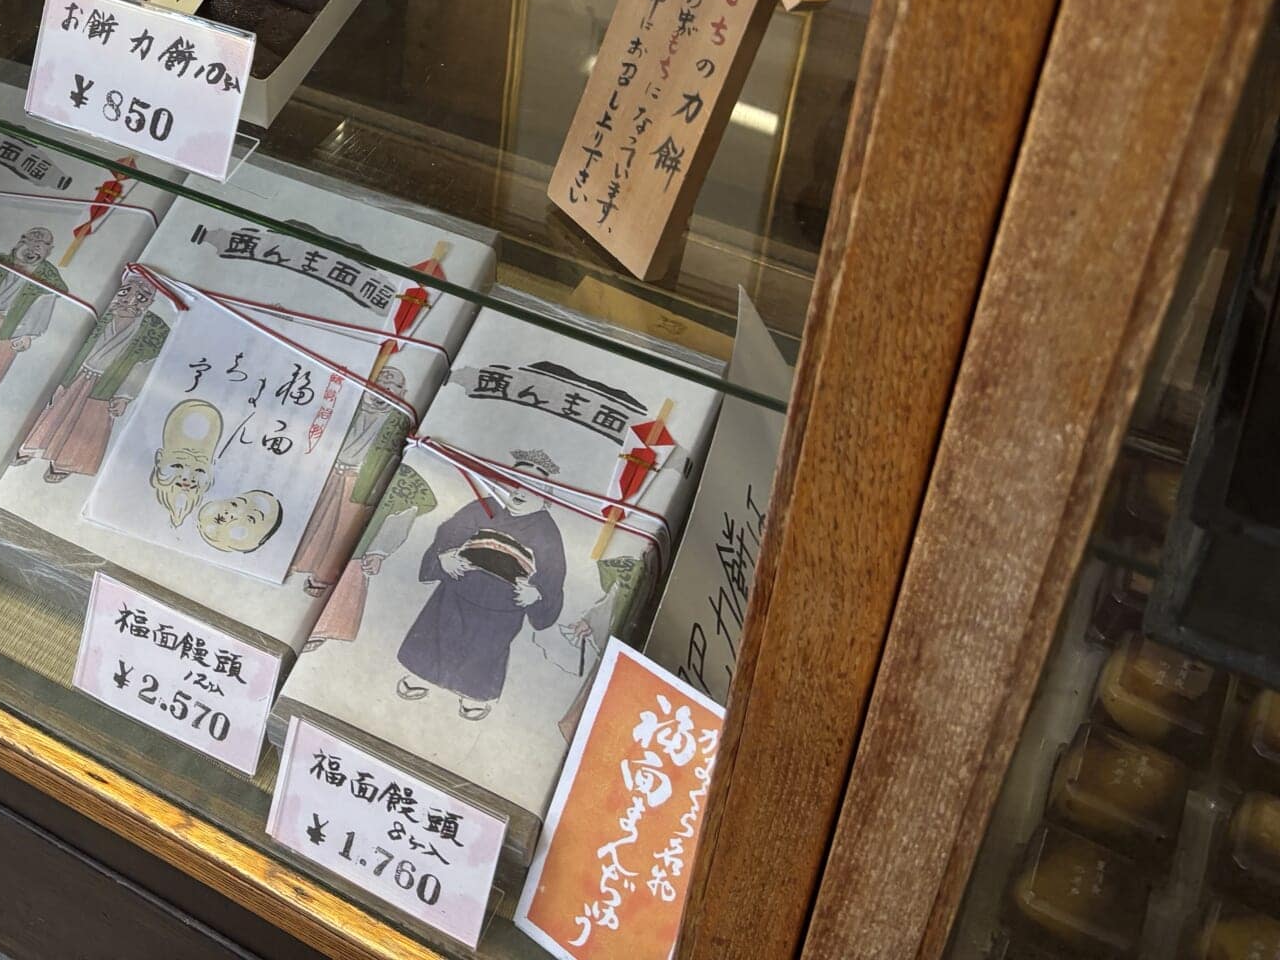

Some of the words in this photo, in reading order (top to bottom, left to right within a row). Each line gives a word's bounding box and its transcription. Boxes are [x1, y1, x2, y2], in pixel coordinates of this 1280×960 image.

[114, 601, 247, 685] 福面饅頭
[309, 748, 465, 847] 福面饅頭
